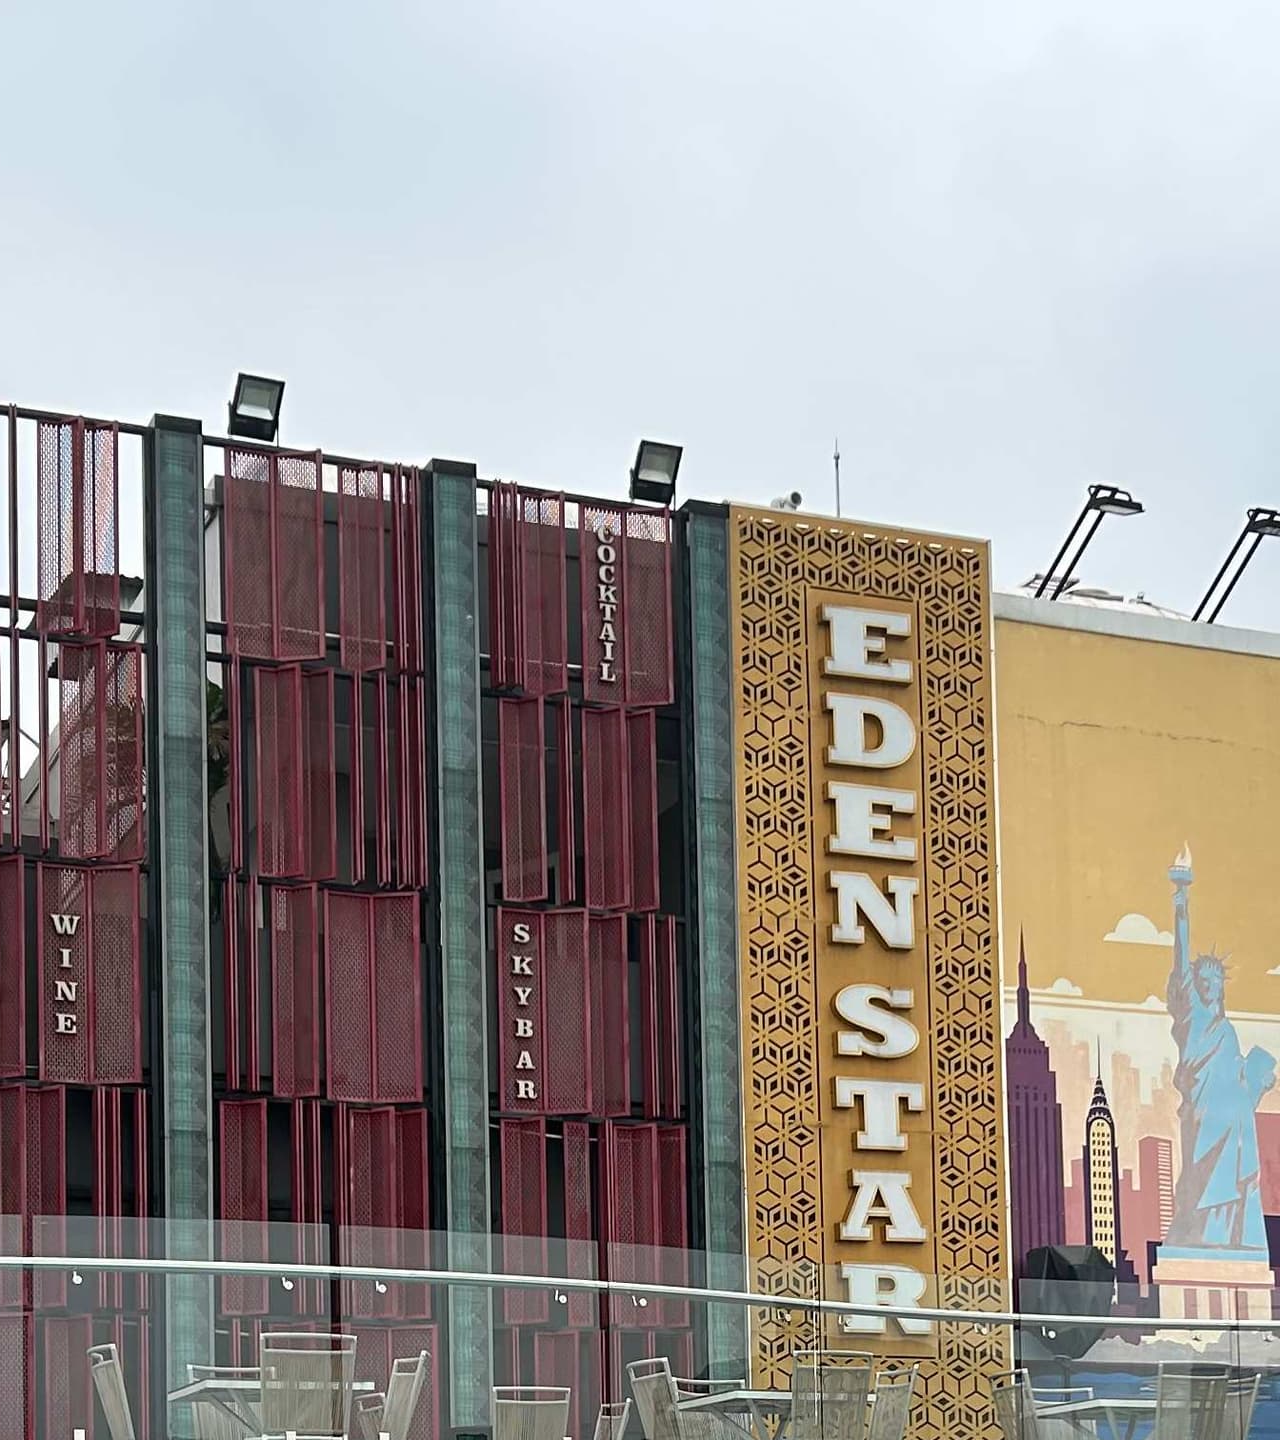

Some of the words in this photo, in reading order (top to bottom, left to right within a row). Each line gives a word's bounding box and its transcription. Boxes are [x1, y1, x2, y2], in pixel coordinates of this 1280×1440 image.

[597, 525, 618, 683] COCKTAIL
[50, 913, 81, 1035] WINE
[511, 923, 538, 1100] SKYBAR
